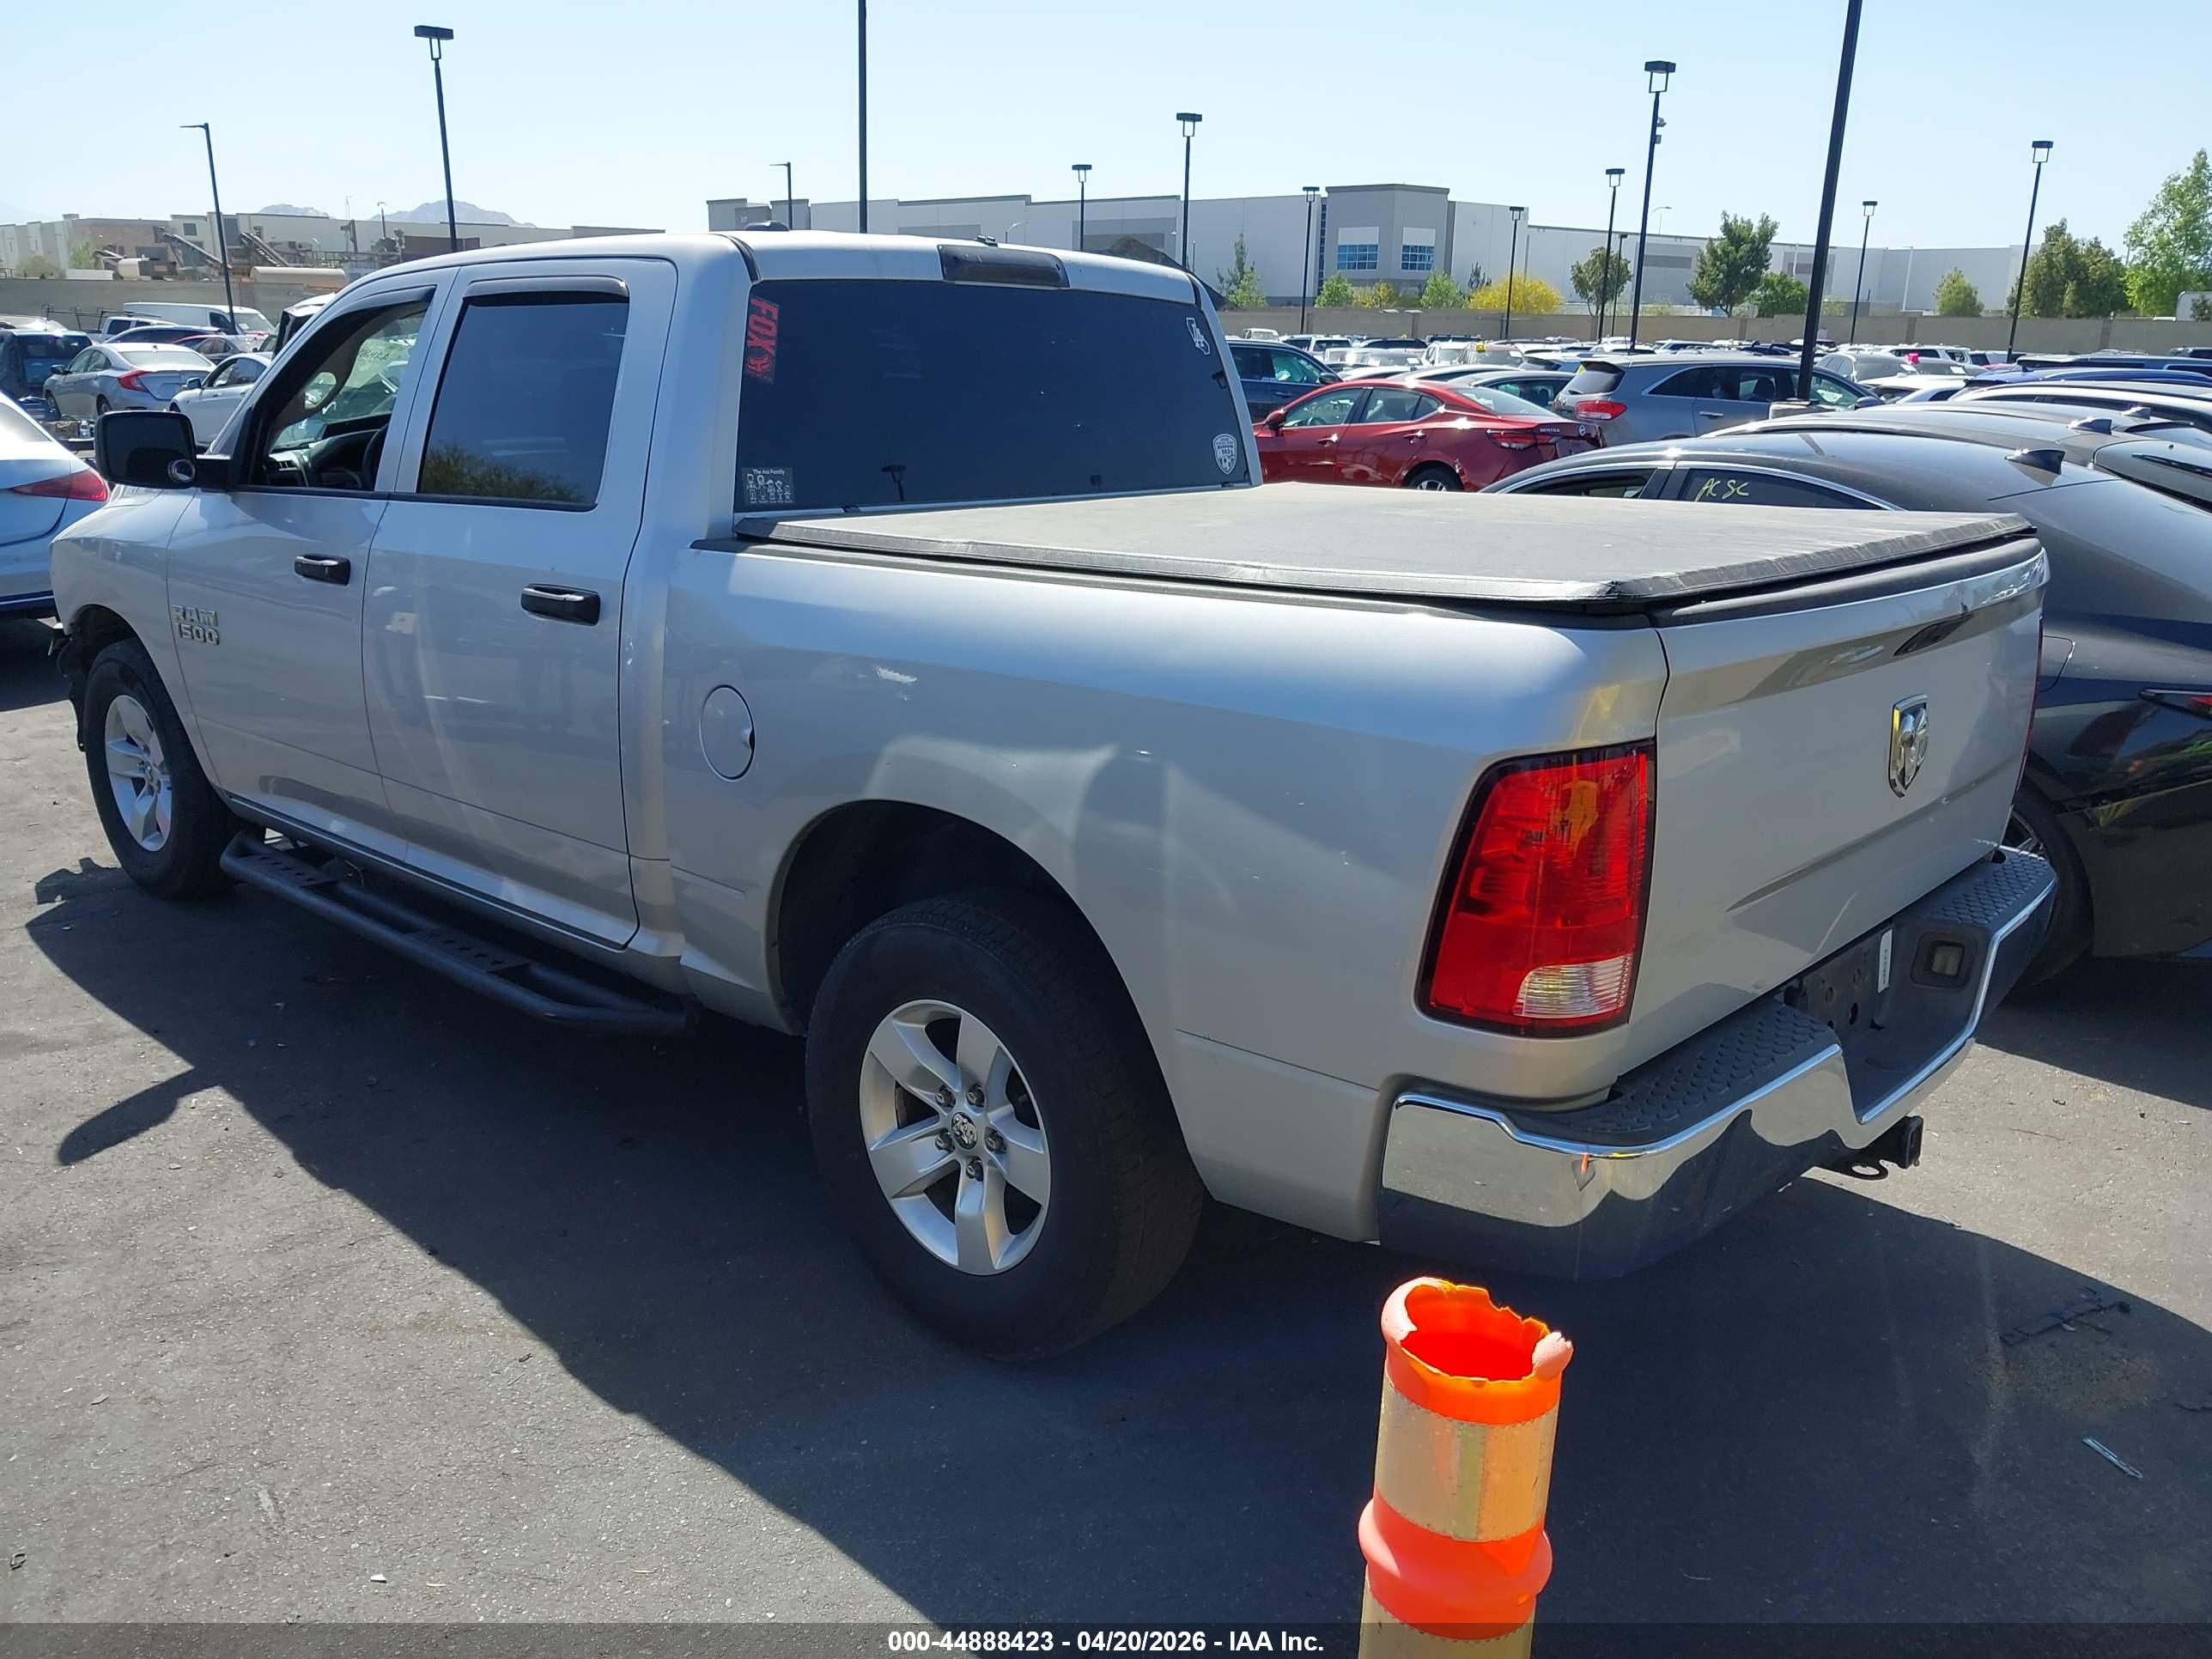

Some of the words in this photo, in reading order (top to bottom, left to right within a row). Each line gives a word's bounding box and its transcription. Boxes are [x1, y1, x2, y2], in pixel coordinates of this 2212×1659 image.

[748, 297, 778, 356] FOX
[172, 605, 218, 627] RAM
[173, 623, 220, 645] 1500
